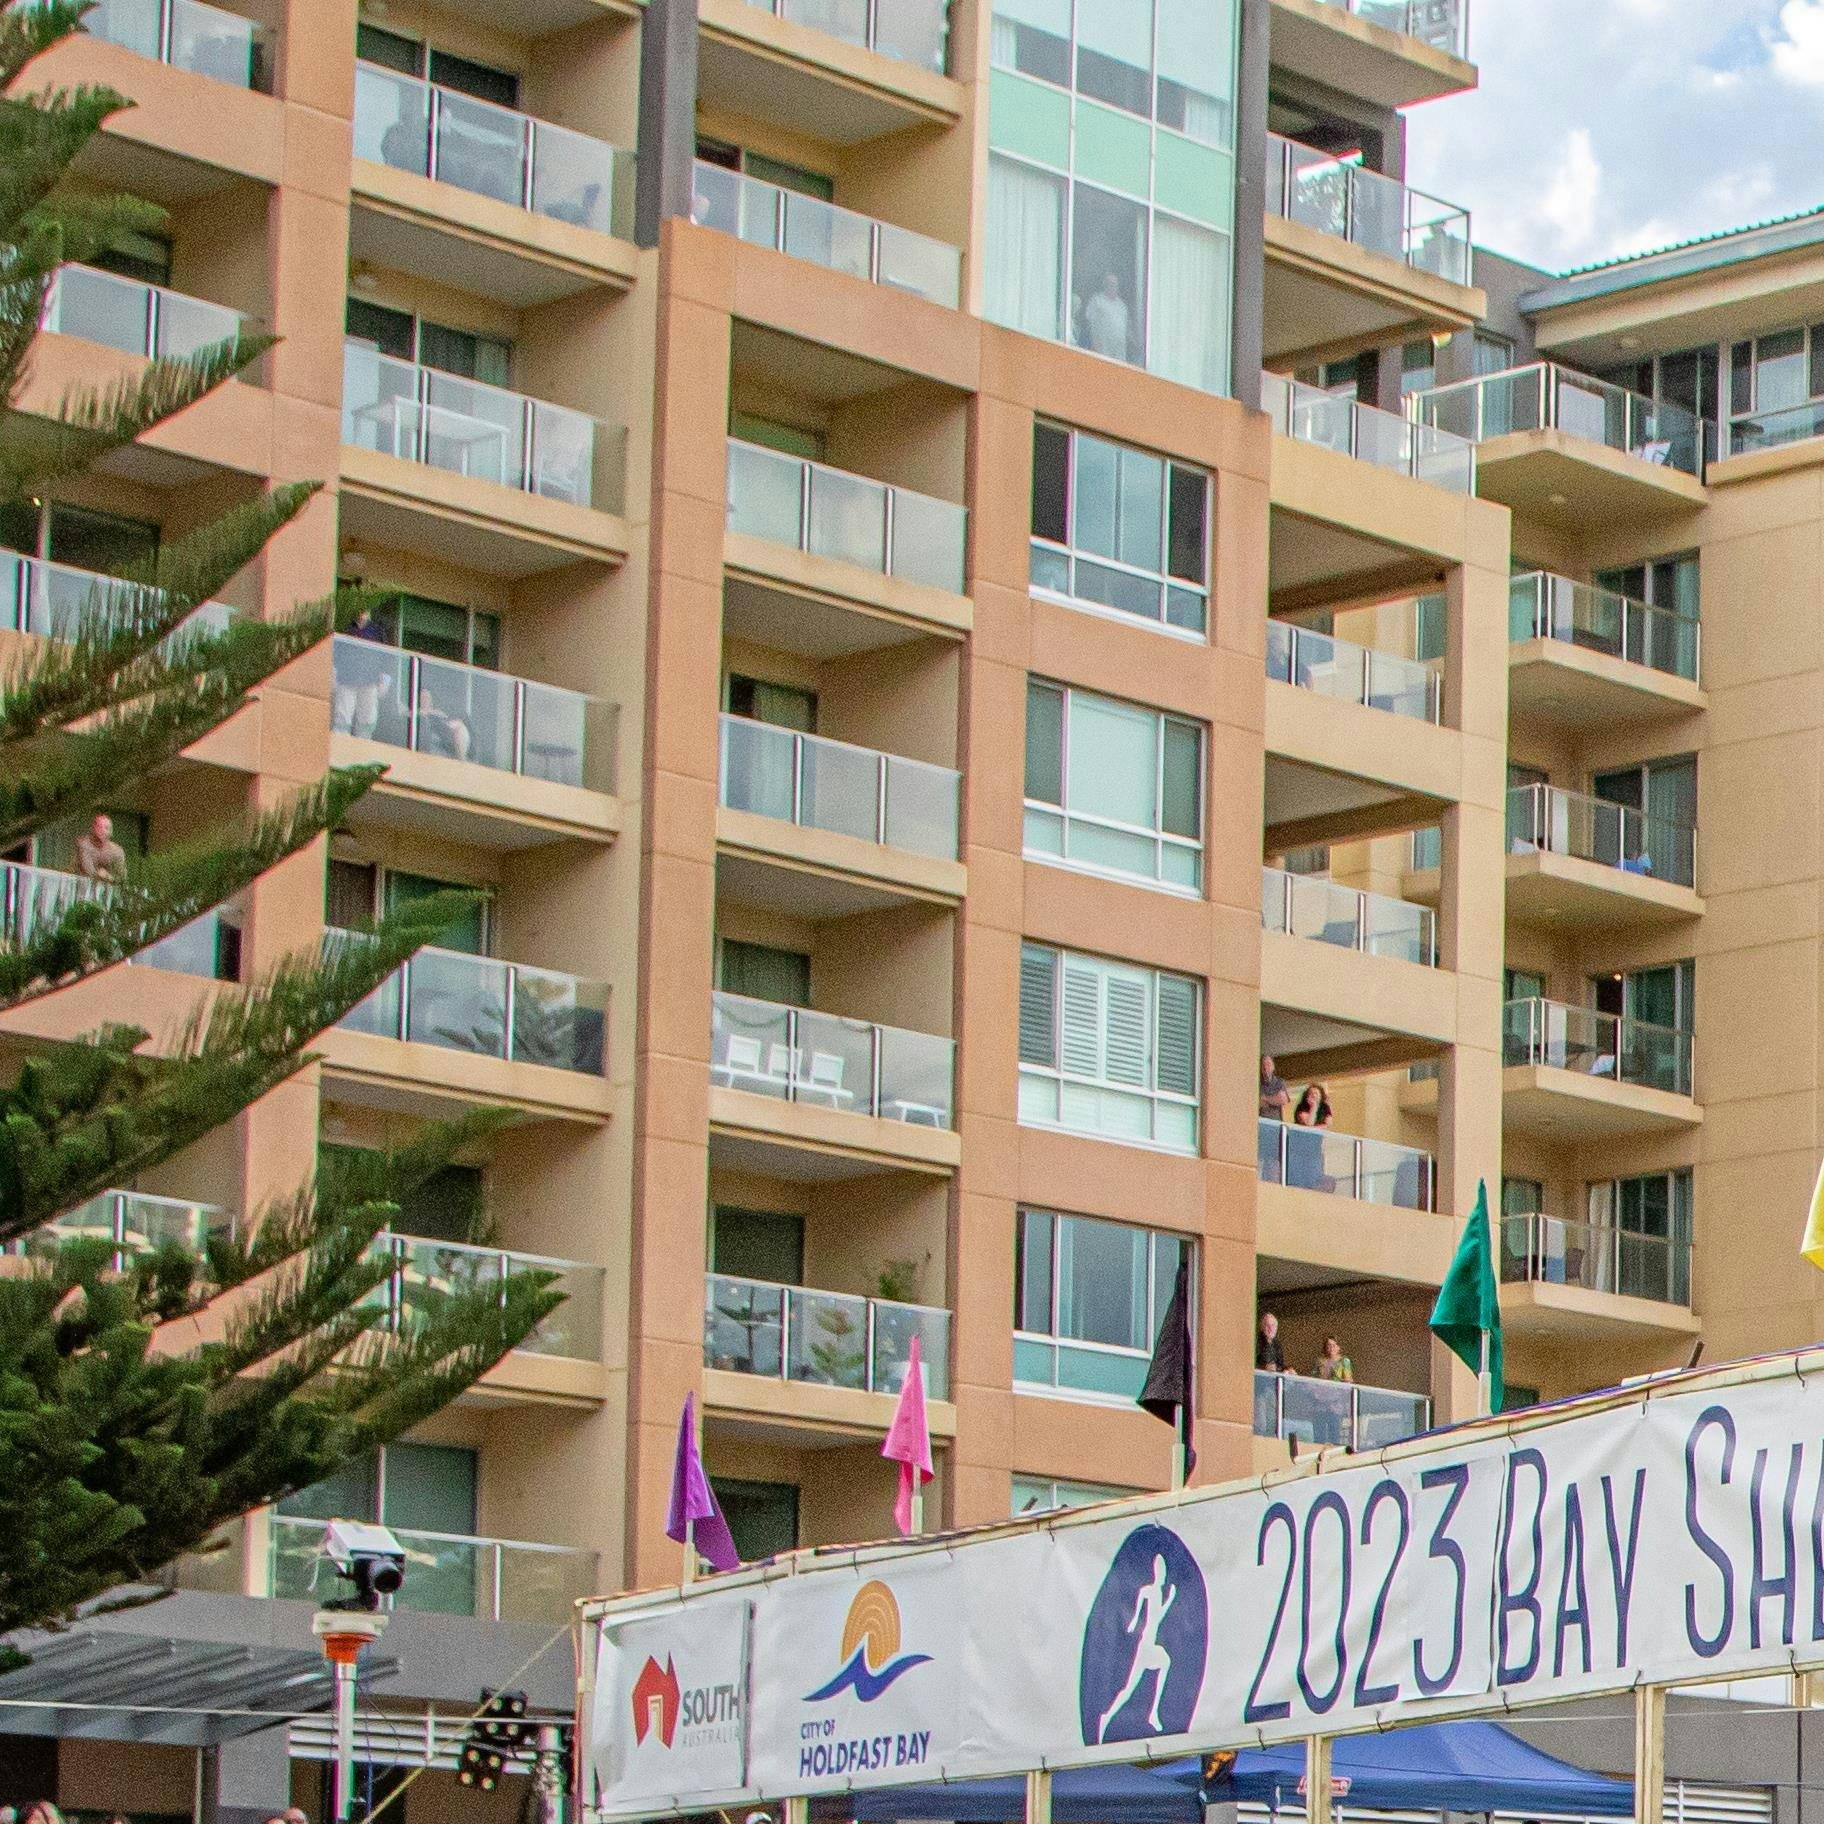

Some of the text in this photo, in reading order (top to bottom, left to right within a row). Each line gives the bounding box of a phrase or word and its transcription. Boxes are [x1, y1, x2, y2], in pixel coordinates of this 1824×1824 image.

[1243, 1461, 1470, 1725] 2023
[1495, 1447, 1647, 1687] BAY
[682, 1684, 742, 1727] SOUTH
[801, 1718, 836, 1741] CITY OF
[800, 1730, 931, 1778] HOLDFAST BAY
